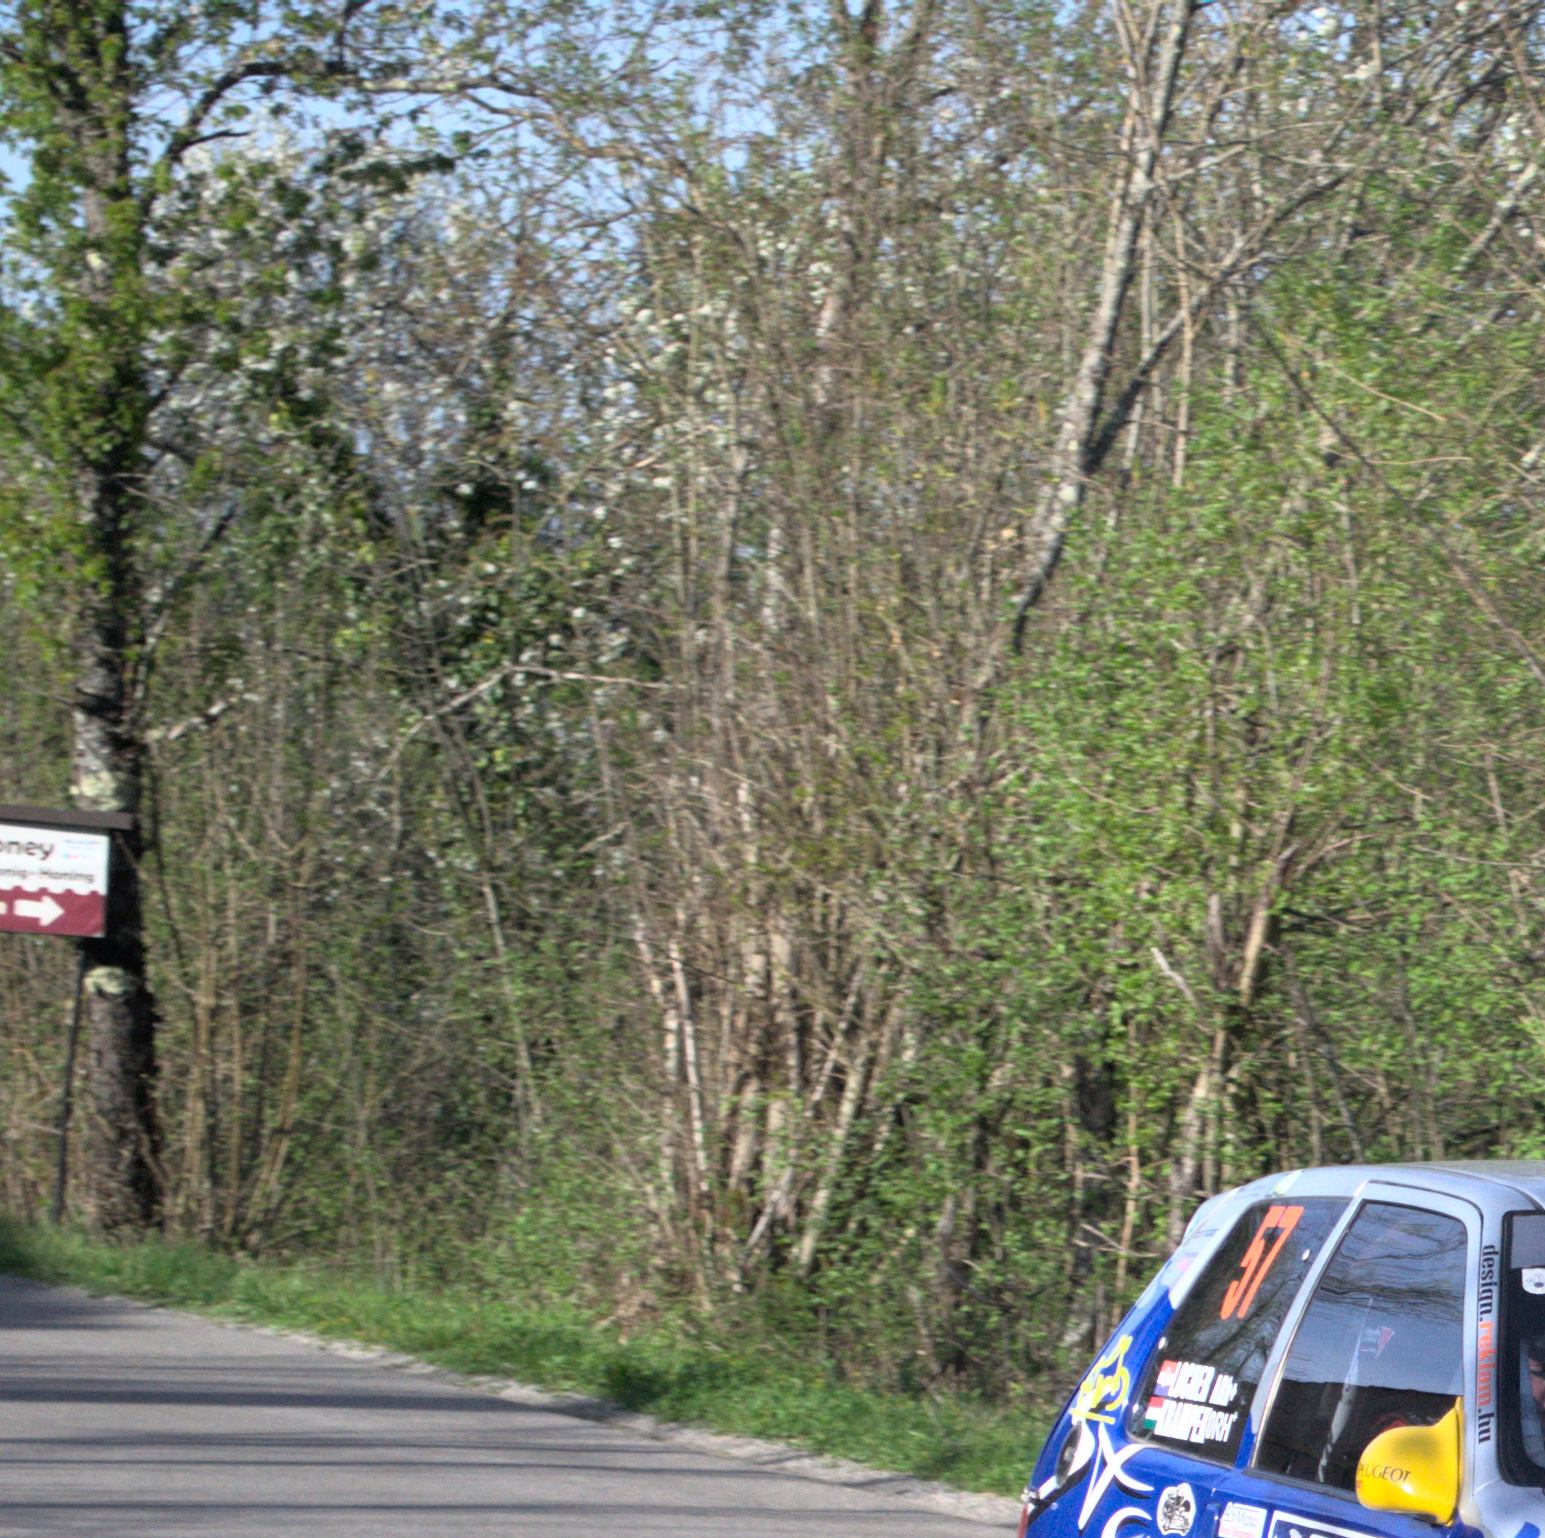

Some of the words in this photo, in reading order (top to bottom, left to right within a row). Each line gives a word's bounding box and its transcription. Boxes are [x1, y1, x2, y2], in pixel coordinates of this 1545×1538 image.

[0, 840, 54, 861] ney
[1220, 1205, 1305, 1320] 57
[1477, 1244, 1499, 1445] design.reklam.hu
